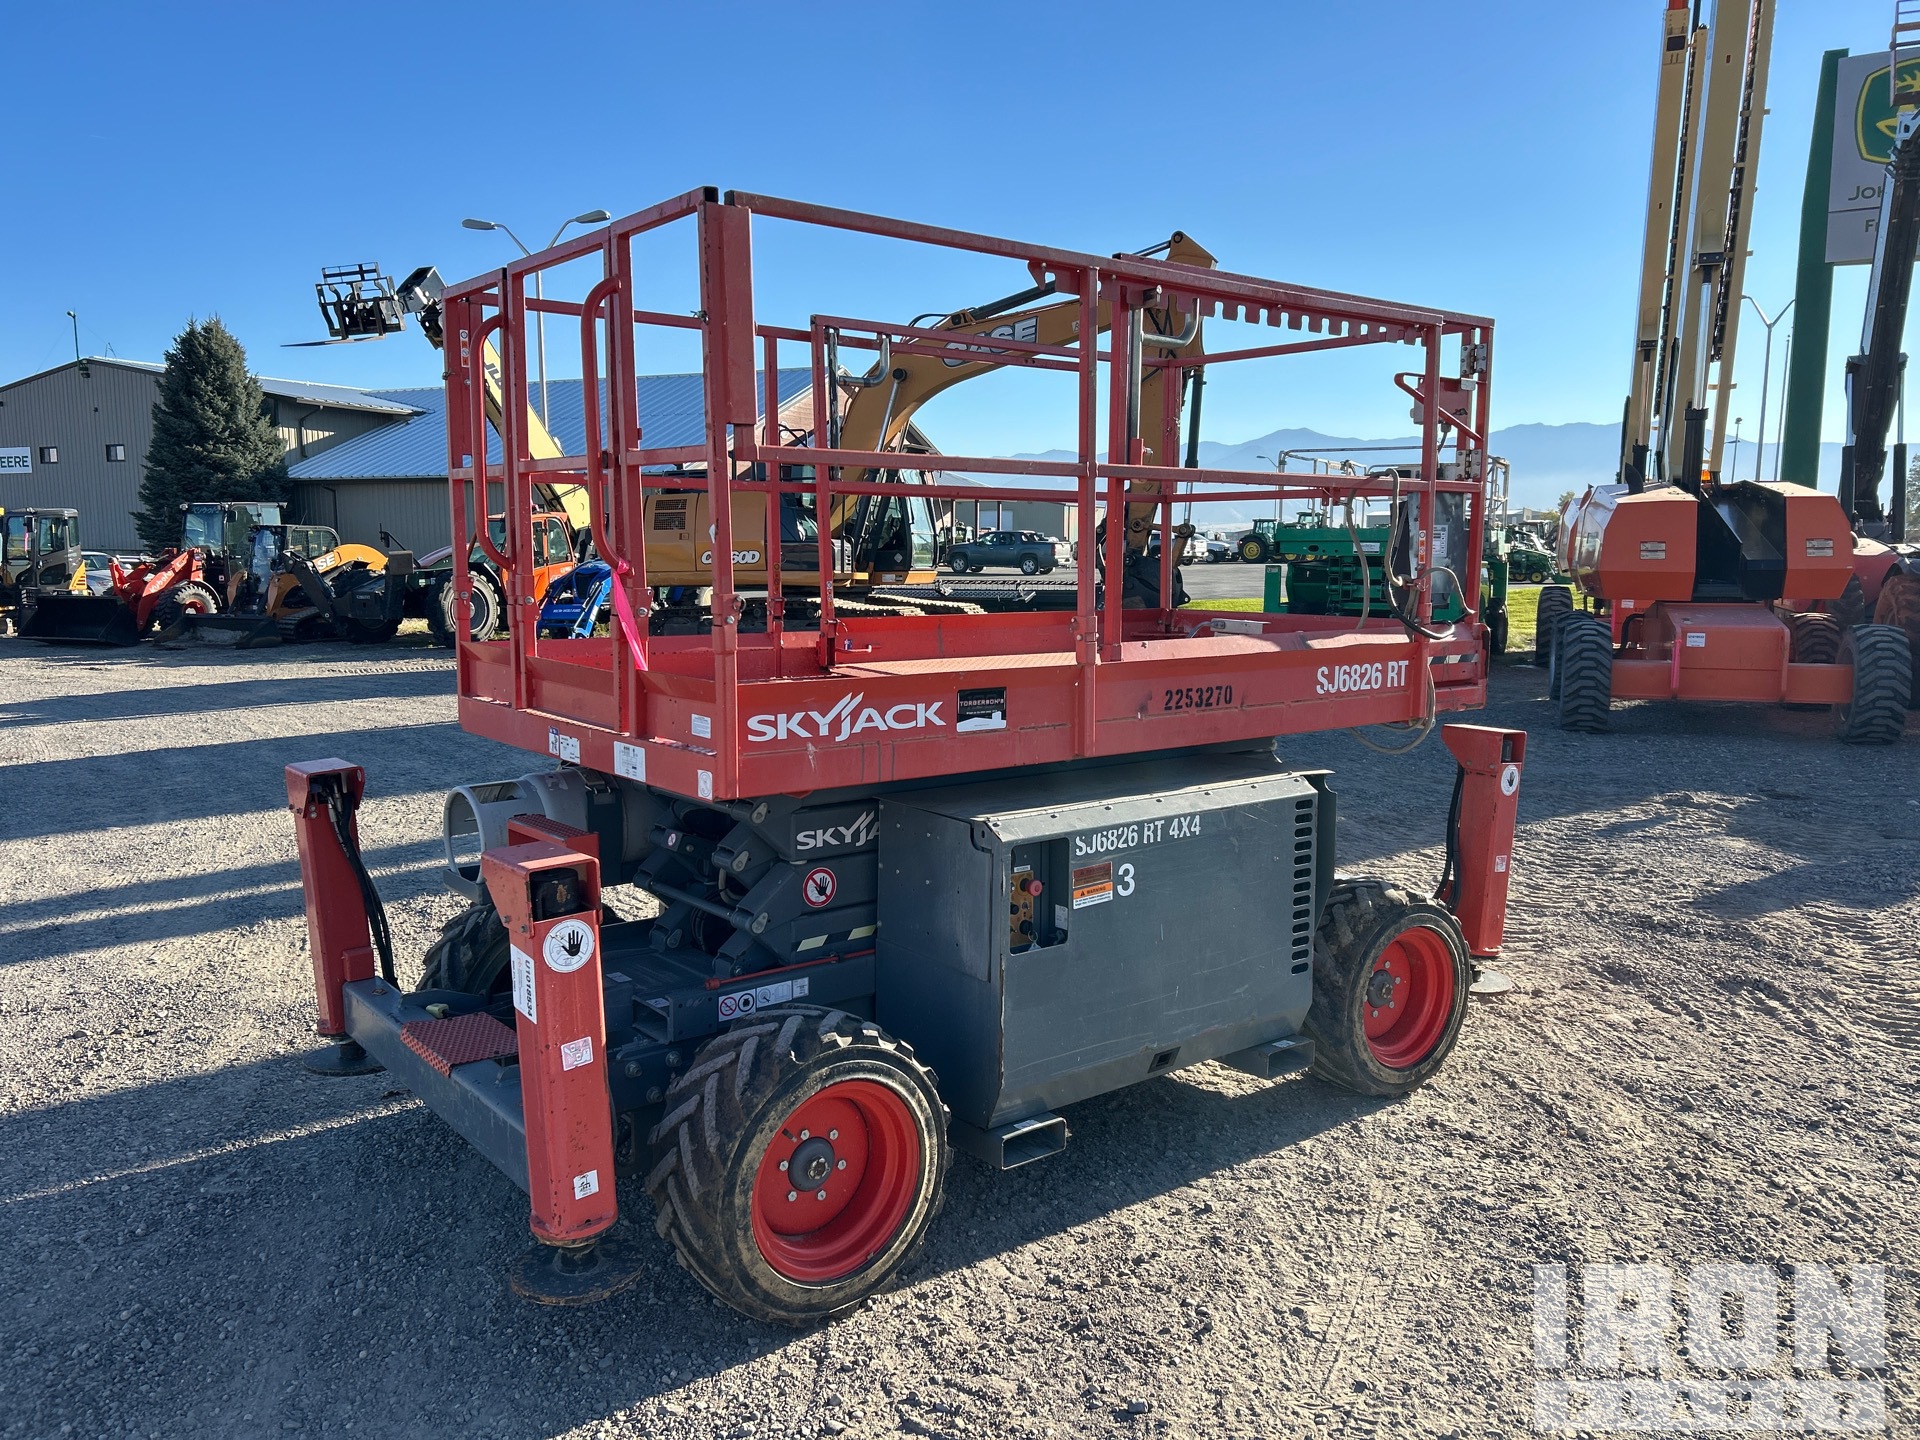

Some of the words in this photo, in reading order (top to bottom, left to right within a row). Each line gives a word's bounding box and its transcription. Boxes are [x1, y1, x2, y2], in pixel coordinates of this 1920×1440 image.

[0, 456, 29, 468] EERE
[317, 554, 336, 571] SE
[150, 570, 173, 593] Kubota
[1316, 663, 1381, 694] SJ6826
[1387, 660, 1409, 688] RT
[1164, 685, 1232, 711] 2253270
[747, 691, 946, 742] SKYJACK
[797, 811, 880, 850] SKYJA
[1076, 825, 1138, 856] SJ6826
[1143, 819, 1165, 844] RT
[1169, 815, 1202, 839] 4X4
[1117, 863, 1136, 897] 3
